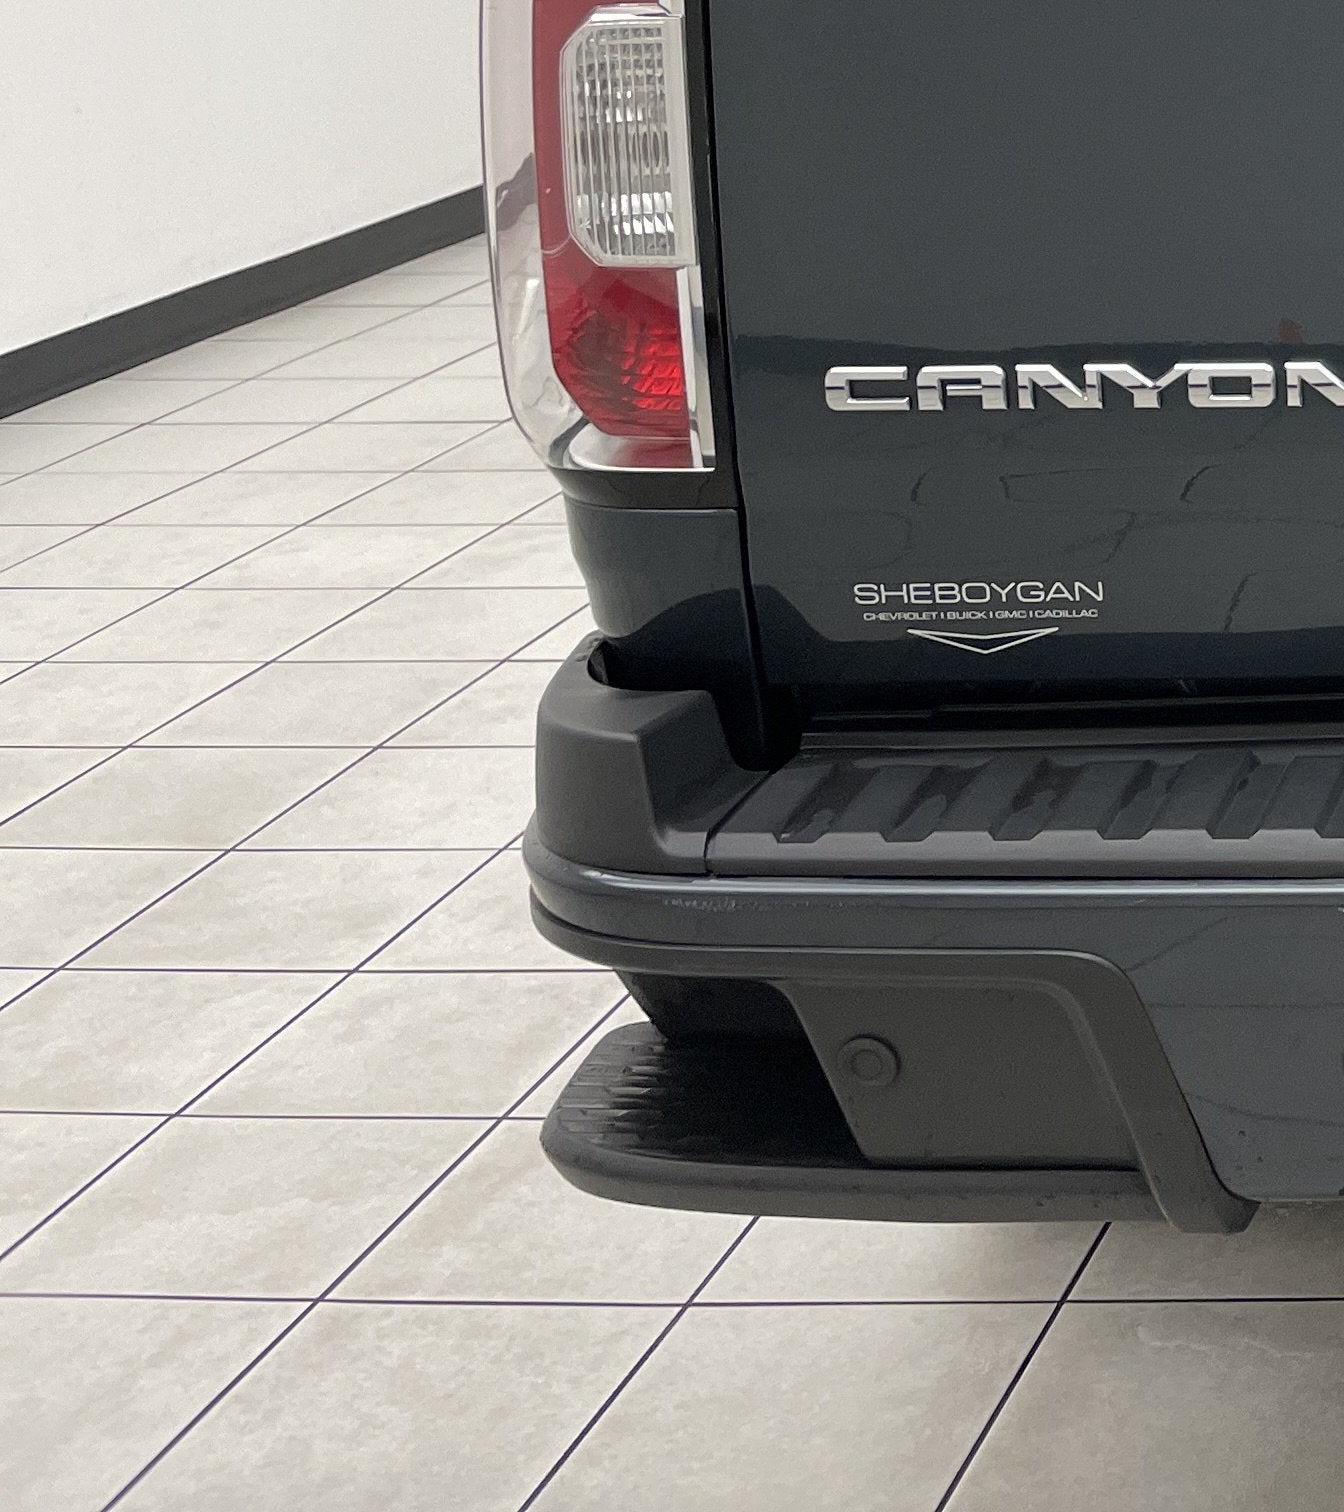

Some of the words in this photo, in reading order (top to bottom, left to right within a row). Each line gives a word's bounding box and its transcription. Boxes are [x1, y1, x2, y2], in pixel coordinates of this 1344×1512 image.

[853, 581, 1103, 605] SHEBOYGAN
[863, 611, 938, 621] CHEVROLET
[949, 611, 989, 620] BUICK
[995, 610, 1028, 619] GMC
[1034, 608, 1098, 618] CADILLAC
